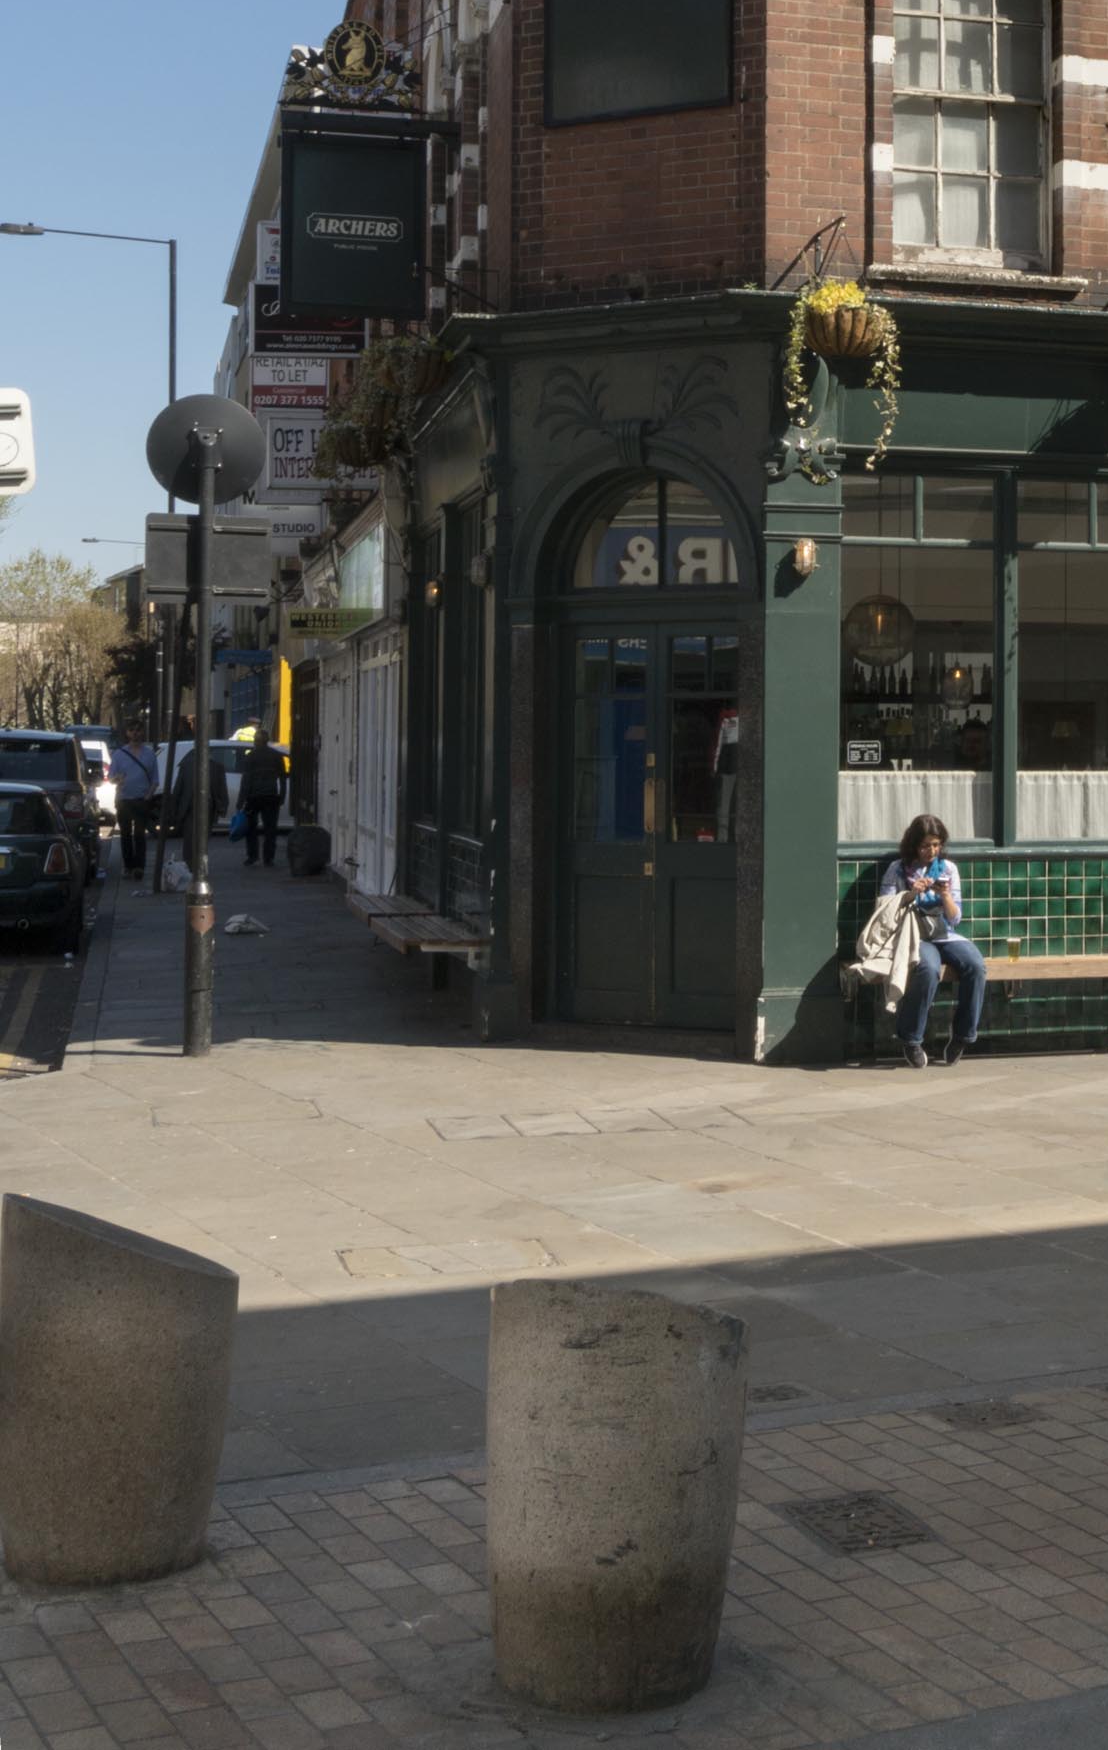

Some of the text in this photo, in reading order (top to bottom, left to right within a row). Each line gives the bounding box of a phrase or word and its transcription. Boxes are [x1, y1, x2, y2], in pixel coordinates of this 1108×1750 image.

[313, 217, 398, 238] ARCHERS
[255, 356, 293, 367] RETAIL
[271, 369, 309, 382] TO LET
[254, 395, 324, 405] 0207 377 1555
[274, 428, 304, 453] OFF
[272, 523, 316, 533] STUDIO
